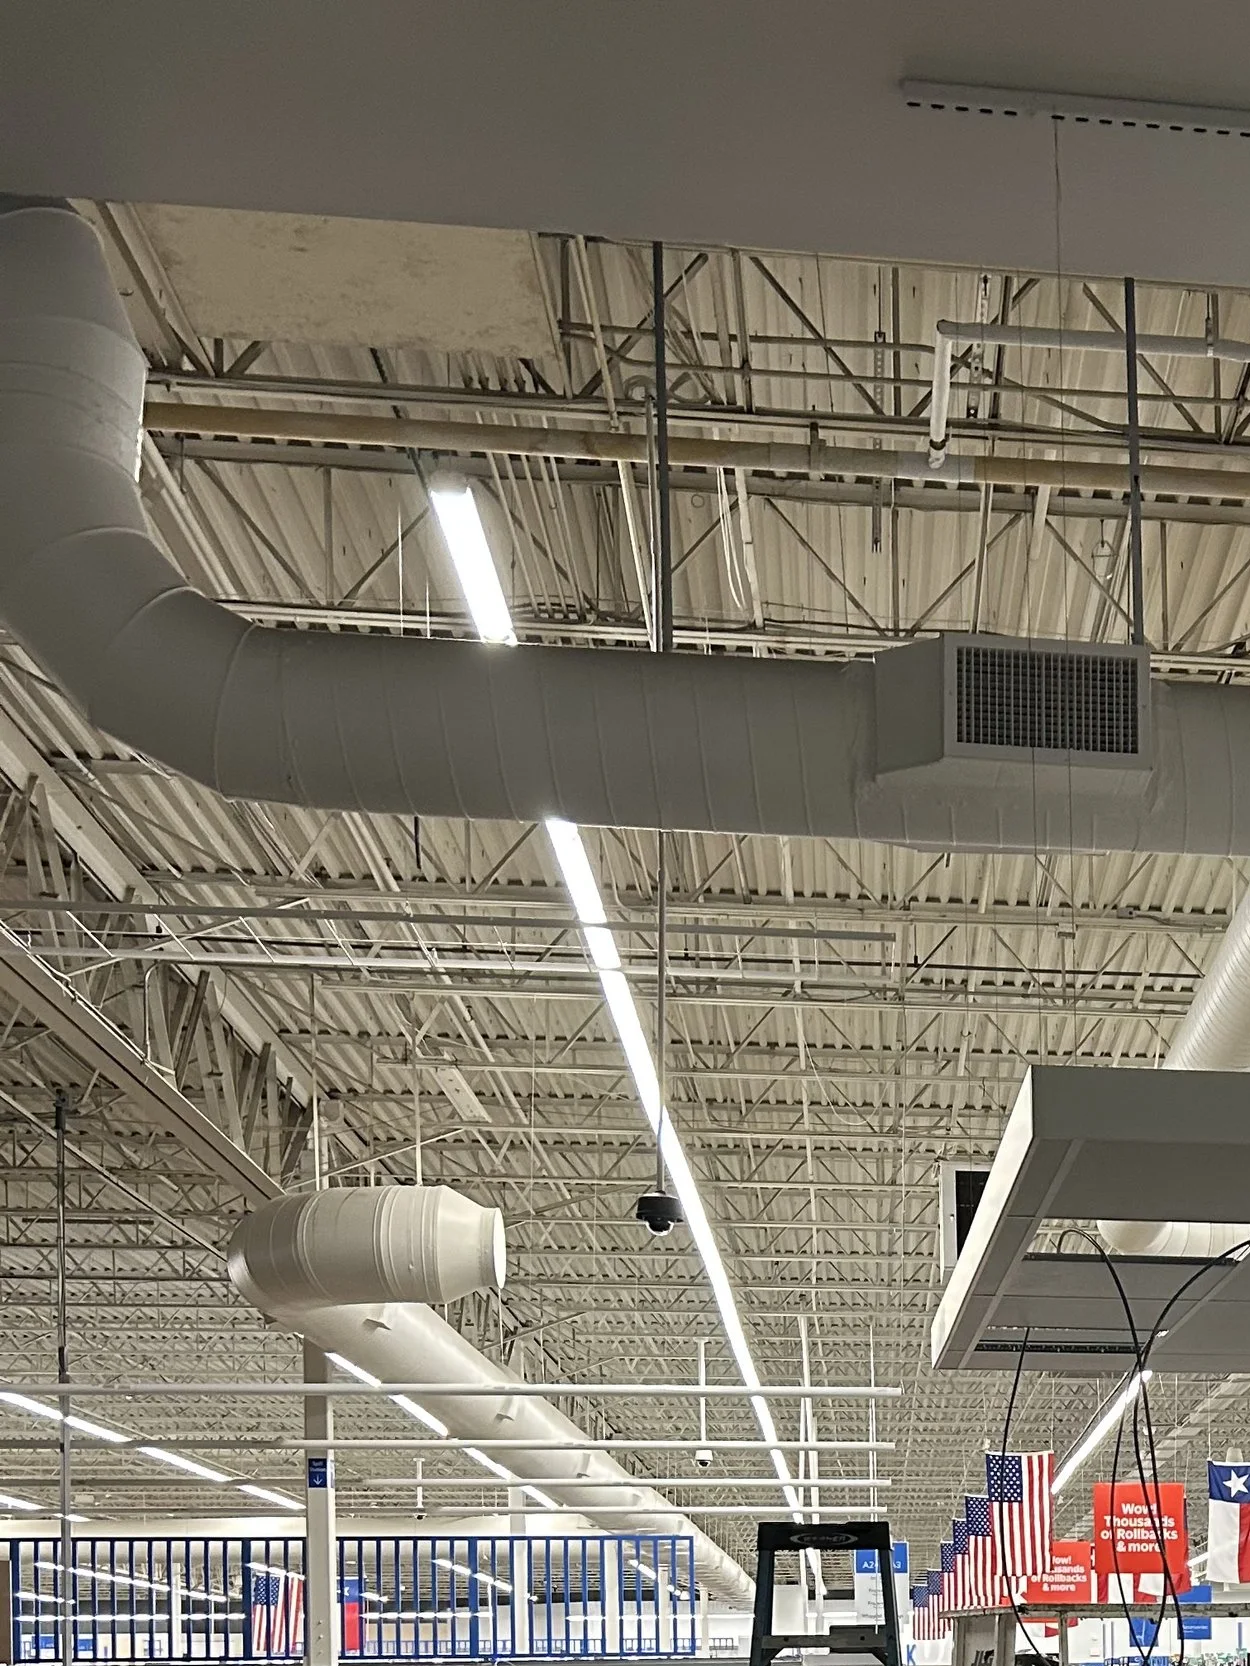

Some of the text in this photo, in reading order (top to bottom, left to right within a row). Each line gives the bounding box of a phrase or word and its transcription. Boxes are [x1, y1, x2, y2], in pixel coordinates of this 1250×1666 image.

[1121, 1503, 1157, 1515] Wow!
[1103, 1515, 1176, 1528] Thousands
[1117, 1528, 1178, 1541] Rollbaks
[1116, 1540, 1127, 1552] &
[1042, 1573, 1087, 1583] Rollbacks
[1050, 1583, 1076, 1592] more
